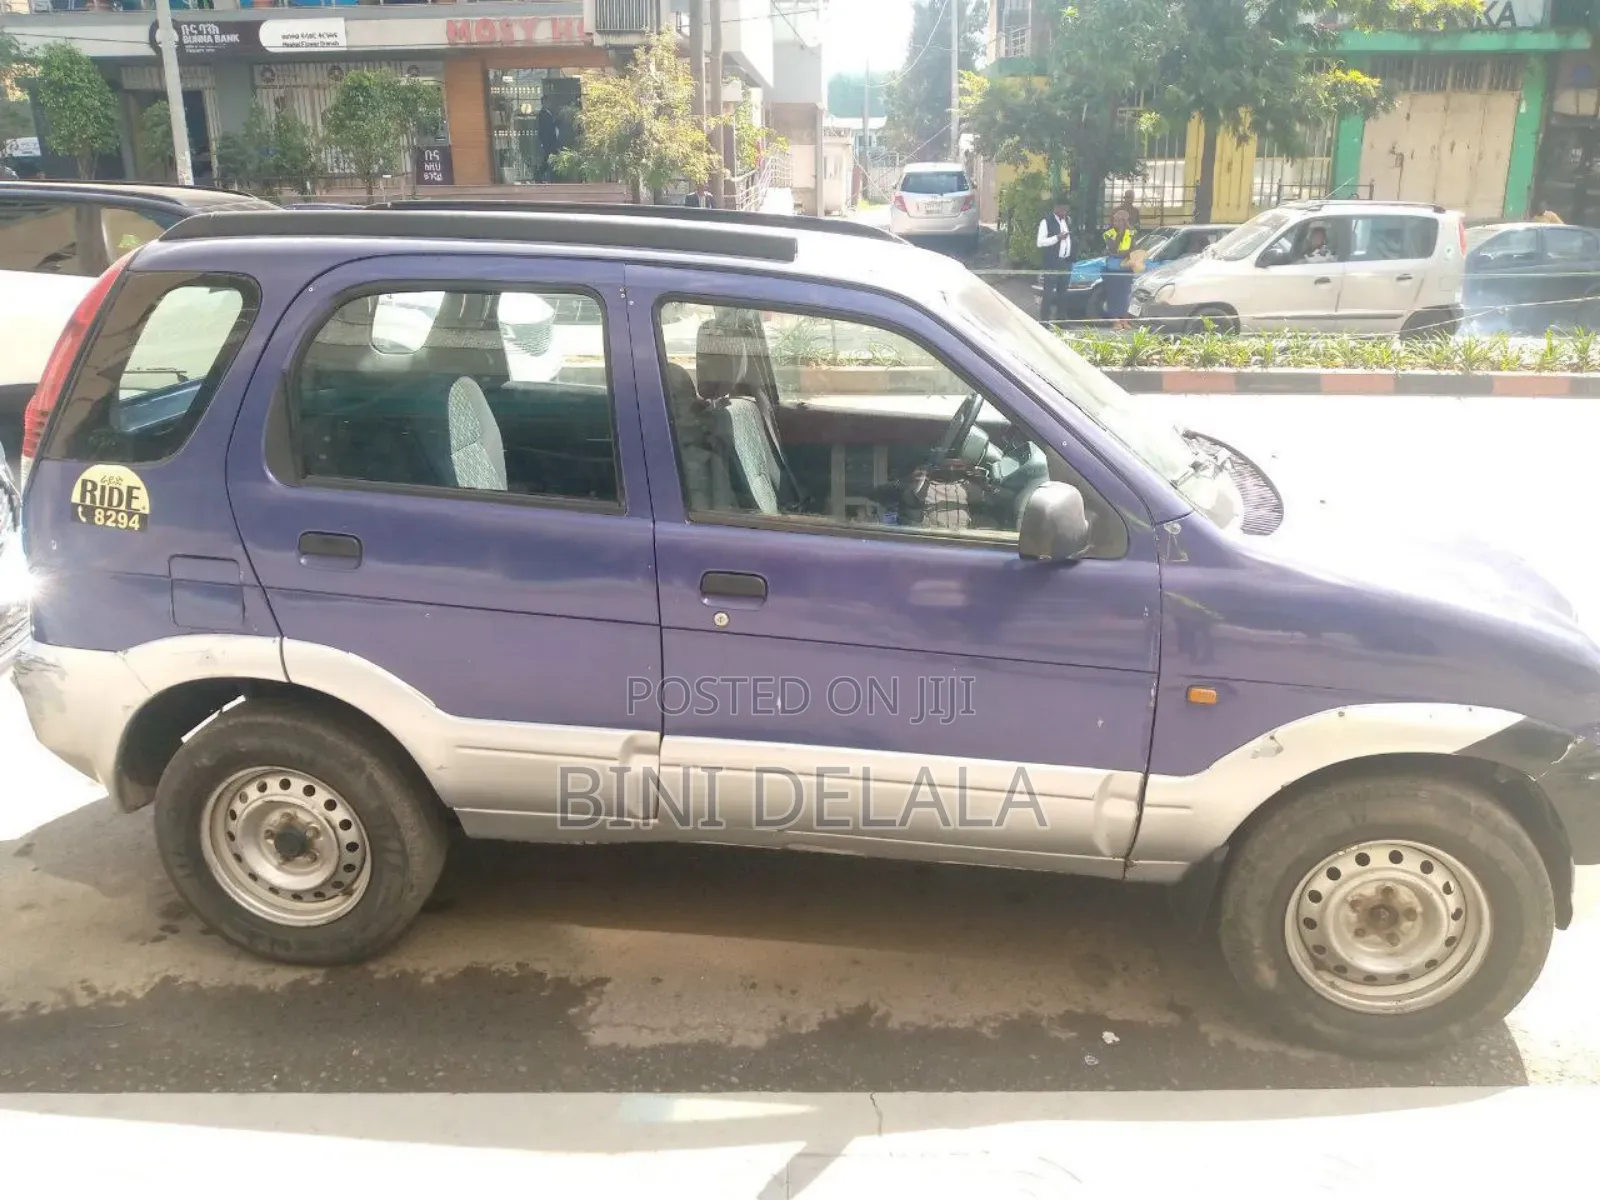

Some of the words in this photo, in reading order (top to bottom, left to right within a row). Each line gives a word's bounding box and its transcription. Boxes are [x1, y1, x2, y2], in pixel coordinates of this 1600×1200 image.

[182, 34, 213, 44] BUNNA
[214, 33, 240, 43] BANK
[446, 17, 539, 45] MOSY
[424, 149, 440, 161] ቡና
[80, 478, 141, 512] RIDE
[94, 508, 141, 531] 8294
